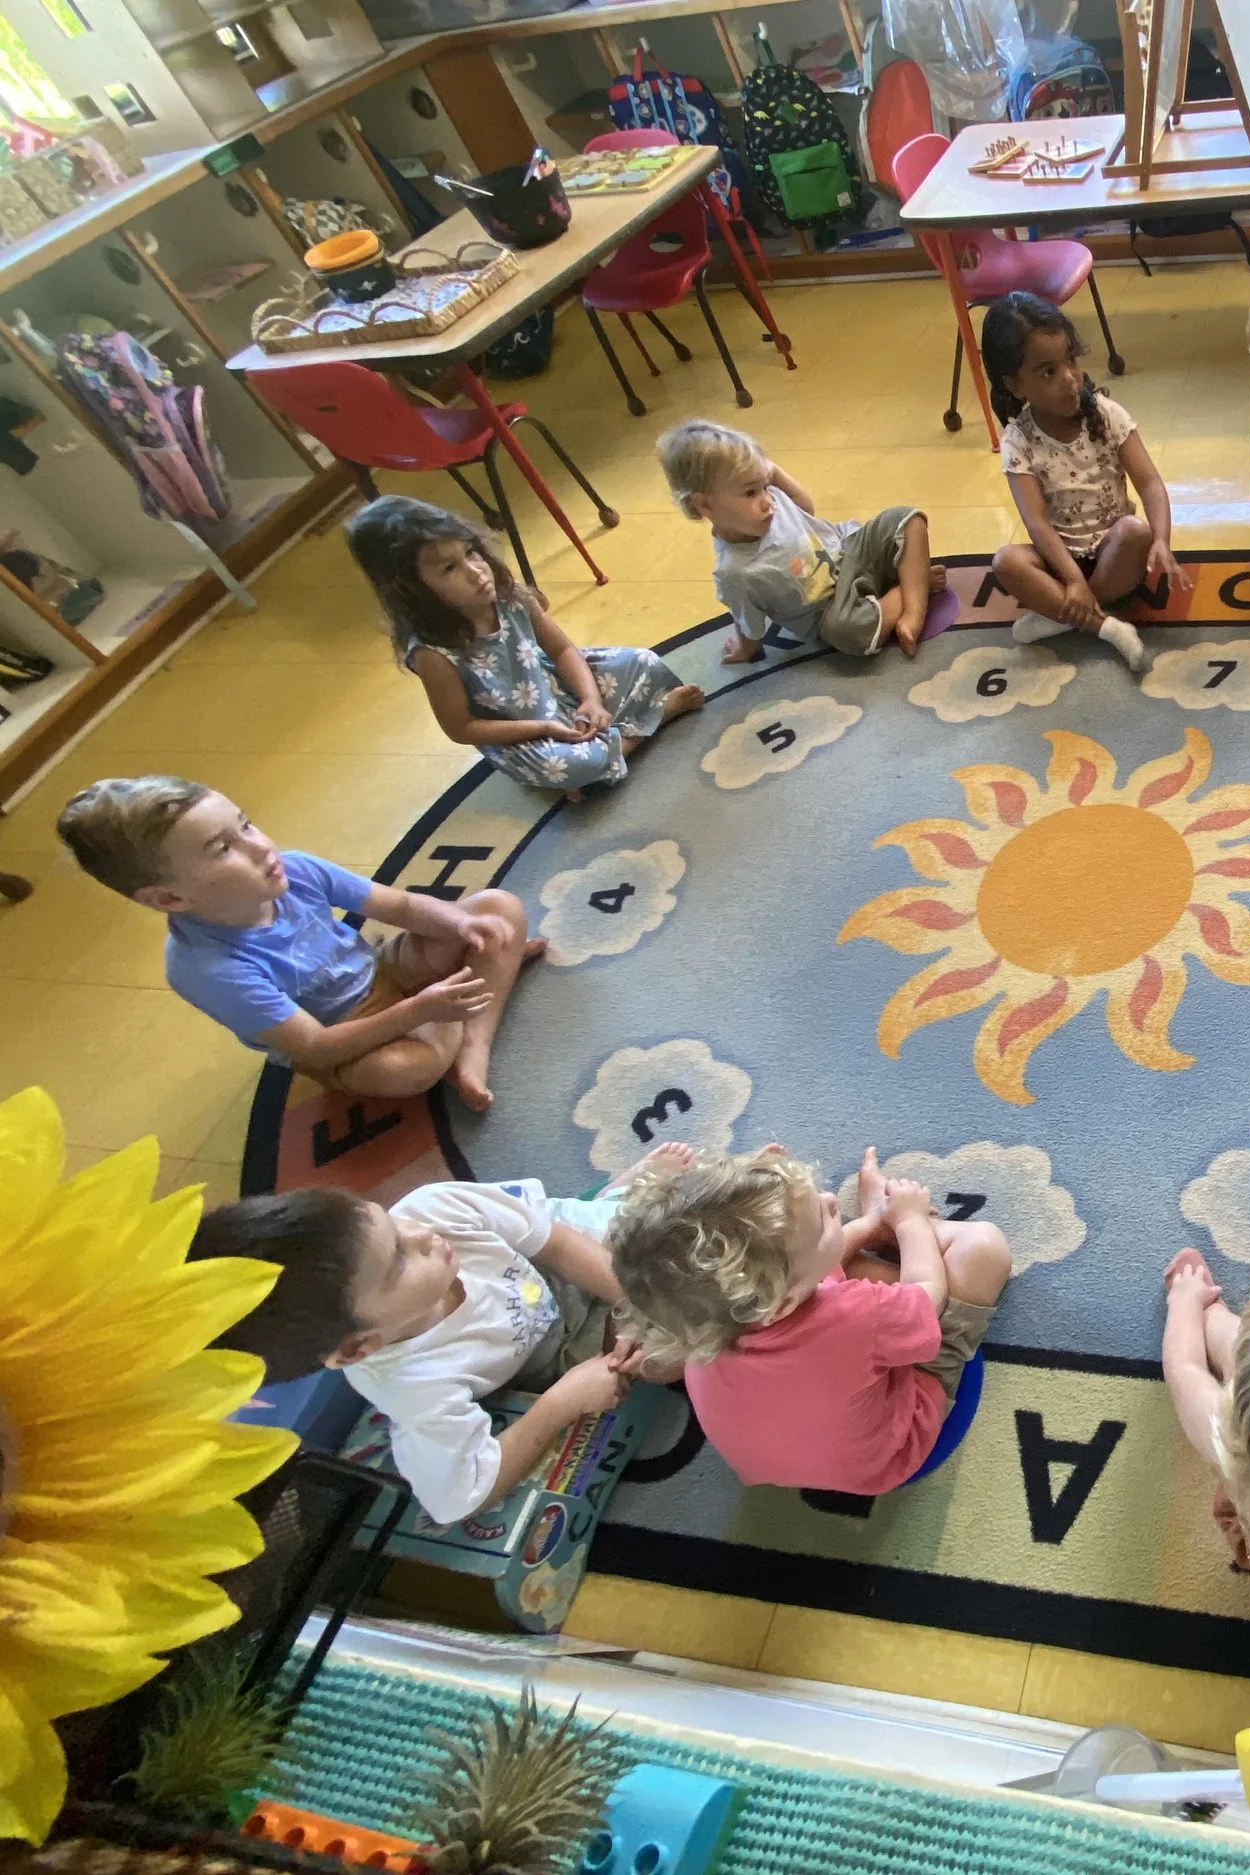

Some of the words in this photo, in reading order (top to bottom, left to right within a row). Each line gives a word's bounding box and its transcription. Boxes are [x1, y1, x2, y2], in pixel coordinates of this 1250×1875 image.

[976, 668, 1007, 697] 6
[1205, 660, 1237, 688] 7
[756, 721, 796, 753] 5
[406, 846, 495, 900] H
[588, 882, 635, 914] 4
[312, 1102, 400, 1168] F
[631, 1088, 693, 1143] 3
[1014, 1409, 1127, 1544] A
